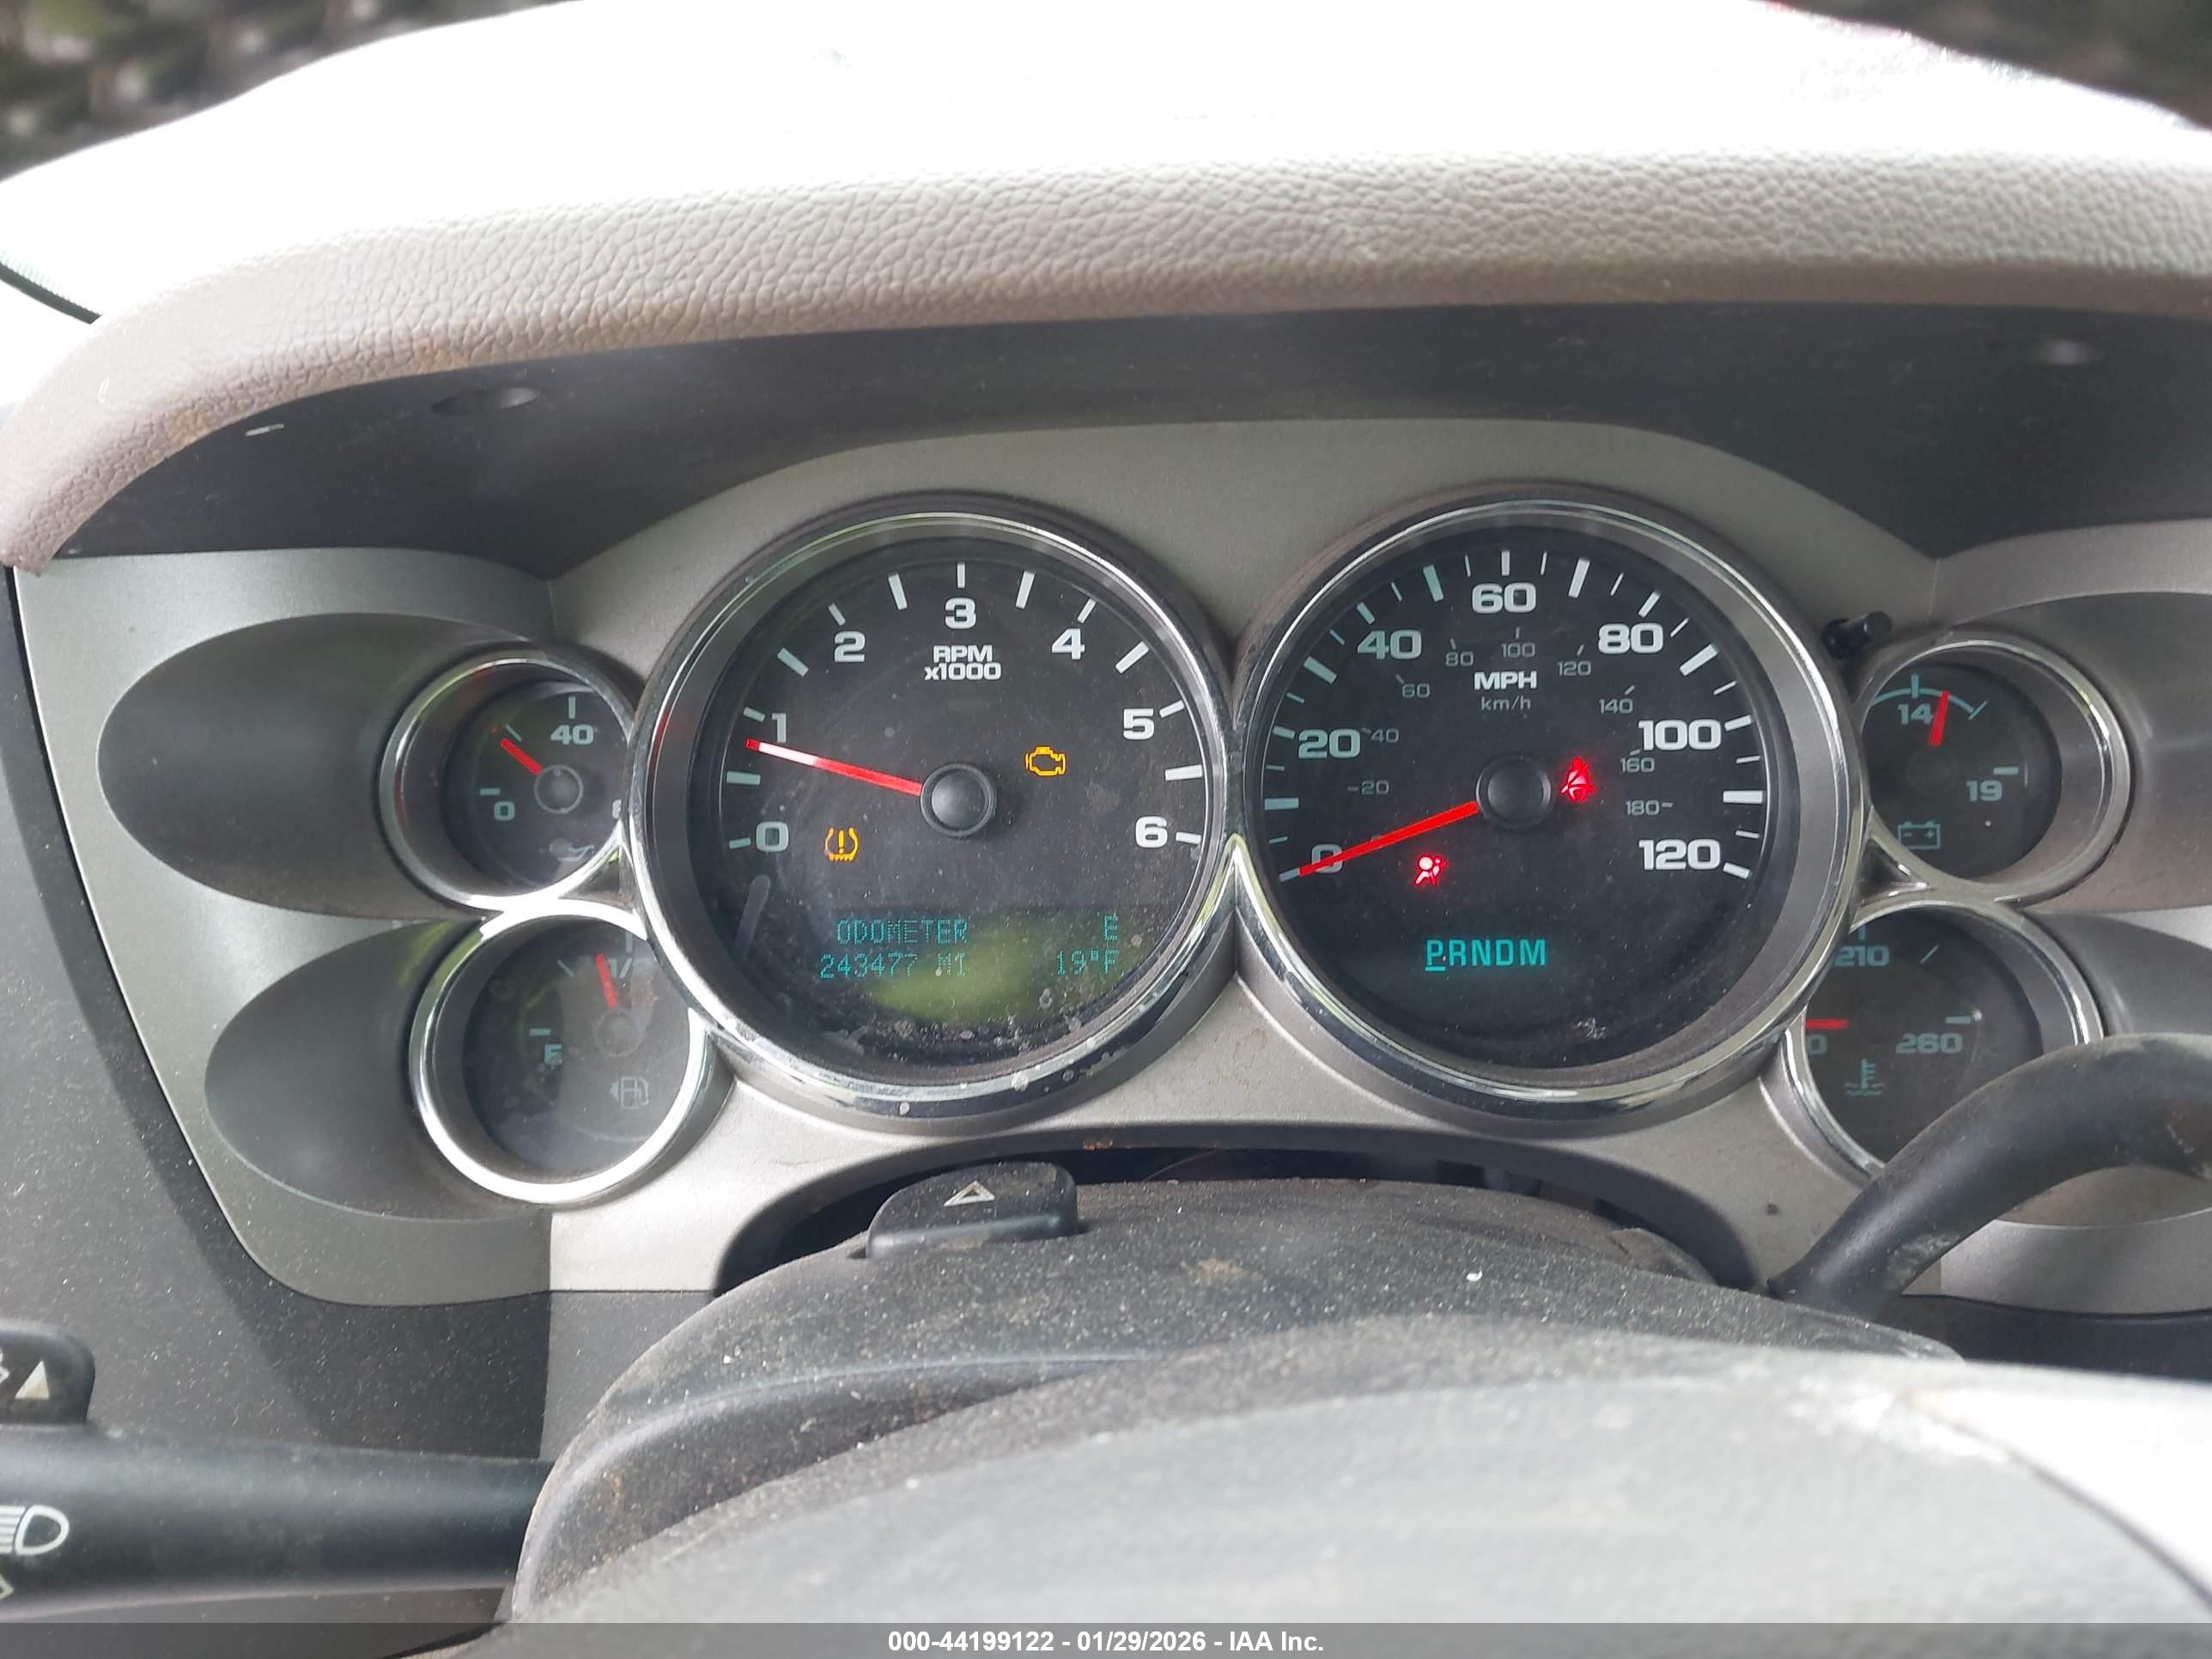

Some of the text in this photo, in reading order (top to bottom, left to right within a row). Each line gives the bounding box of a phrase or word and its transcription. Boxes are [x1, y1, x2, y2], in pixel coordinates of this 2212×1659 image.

[1472, 583, 1537, 614] 60
[945, 597, 976, 629] 3
[834, 630, 866, 663] 2
[1051, 628, 1085, 659] 4
[1357, 629, 1422, 660] 40
[1597, 623, 1664, 654] 80
[933, 645, 993, 663] RPM
[1444, 651, 1474, 667] 80
[1500, 642, 1536, 659] 100
[924, 662, 1002, 681] x1000
[1557, 660, 1592, 677] 120
[1401, 683, 1431, 699] 60
[1474, 671, 1537, 690] MPH
[1480, 695, 1531, 711] km/h
[1599, 698, 1633, 714] 140
[1897, 703, 1934, 726] 14
[550, 724, 595, 745] 40
[771, 713, 787, 744] 1
[1122, 708, 1155, 740] 5
[1370, 727, 1400, 744] 40
[1638, 719, 1722, 750] 100
[1297, 728, 1361, 759] 20
[1620, 757, 1656, 773] 160
[1360, 780, 1389, 795] 20
[1966, 779, 2003, 802] 19
[493, 800, 516, 821] 0
[1625, 799, 1660, 816] 180
[756, 820, 789, 853] 0
[1134, 816, 1169, 848] 6
[1310, 843, 1343, 873] 0
[1638, 838, 1721, 870] 120
[837, 919, 969, 944] ODOMETER
[1103, 913, 1119, 941] E
[819, 951, 966, 980] 243477 MI
[1833, 945, 1890, 967] 210
[544, 1043, 562, 1065] E
[1895, 1032, 1964, 1054] 260
